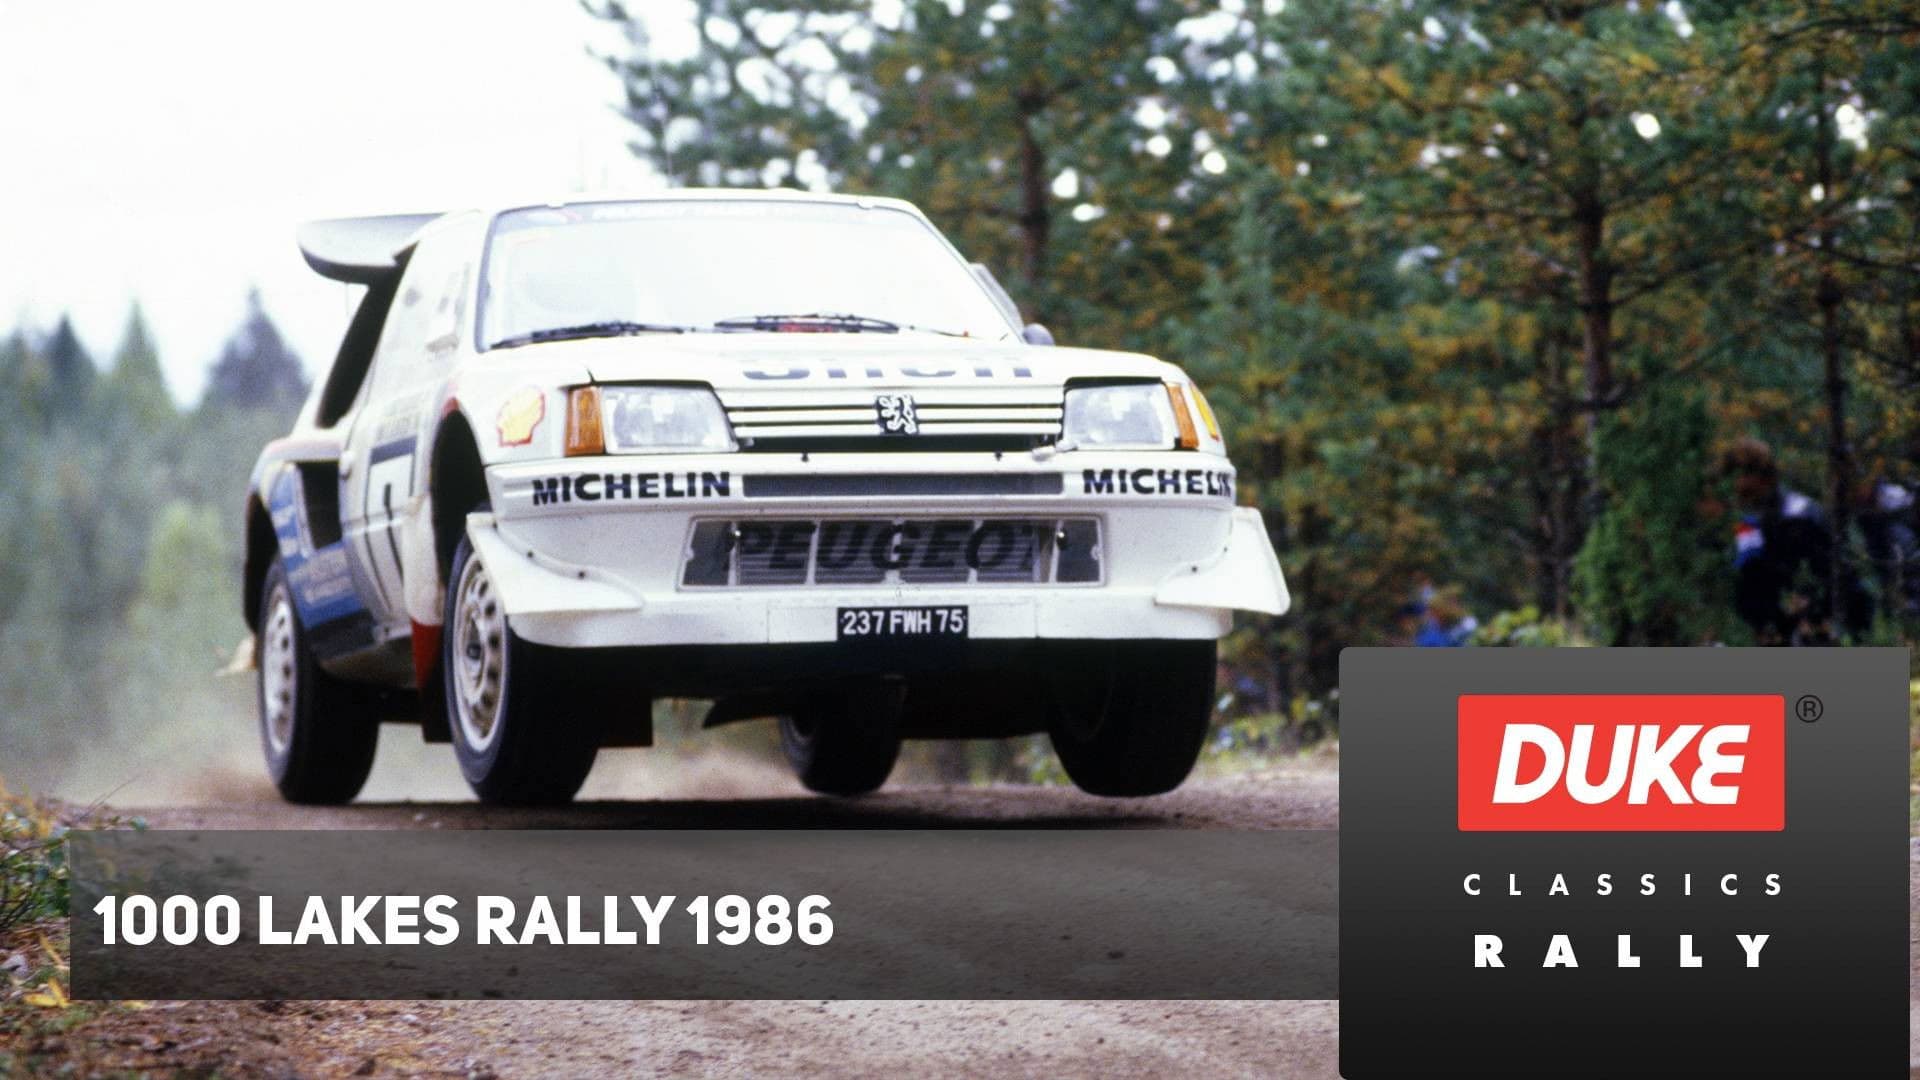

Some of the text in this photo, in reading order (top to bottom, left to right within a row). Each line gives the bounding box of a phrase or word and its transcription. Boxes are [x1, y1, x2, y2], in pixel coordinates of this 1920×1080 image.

[533, 471, 730, 506] MICHELIN
[843, 608, 964, 635] 237 FWH 75
